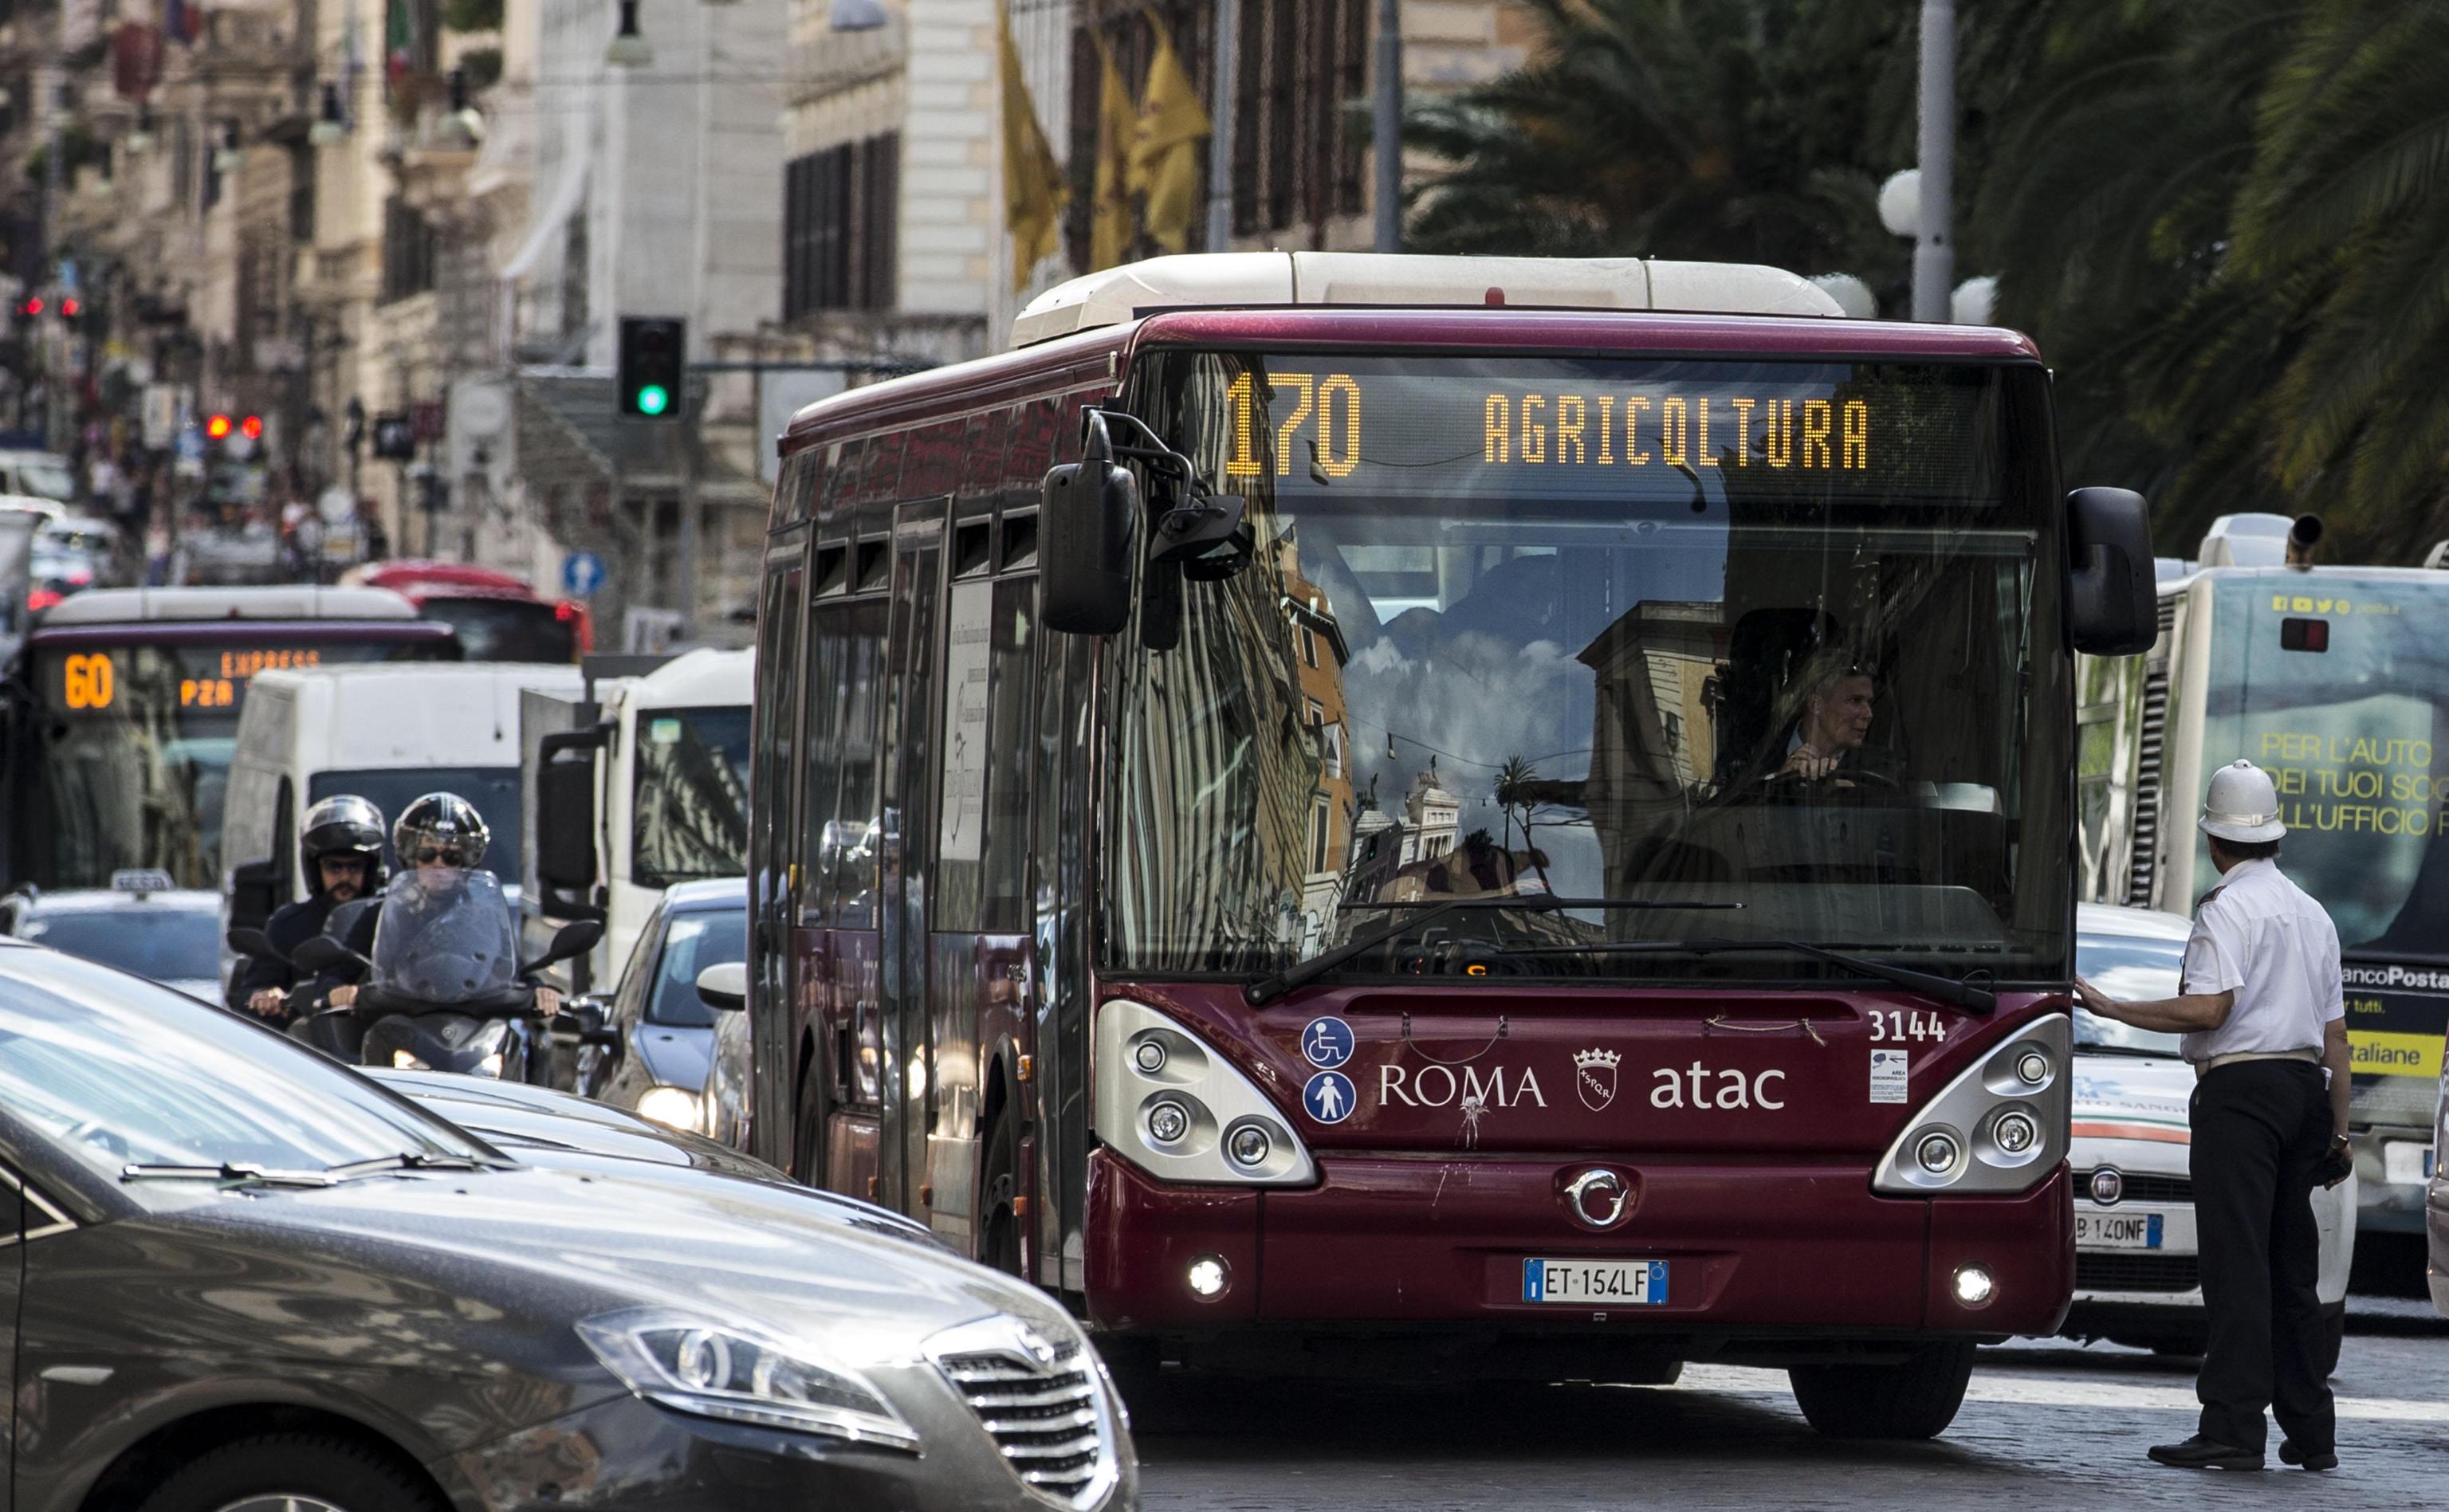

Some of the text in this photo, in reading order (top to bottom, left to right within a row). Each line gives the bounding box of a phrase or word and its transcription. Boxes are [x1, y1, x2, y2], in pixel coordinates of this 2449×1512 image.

[1226, 371, 1867, 478] 170 AGRICOLTURA
[65, 653, 113, 709] 60
[2262, 732, 2432, 768] PER L'AUTO
[2316, 769, 2383, 799] TUOI
[2278, 802, 2430, 836] LL'UFFICIO
[2342, 965, 2449, 989] ancoPosta
[1868, 1010, 1946, 1043] 3144
[2348, 1042, 2420, 1066] taliane
[1378, 1064, 1548, 1108] ROMA
[1649, 1061, 1786, 1110] atac
[2097, 1180, 2117, 1196] FIAT
[1546, 1268, 1571, 1294] ET
[1582, 1269, 1647, 1296] 154LF
